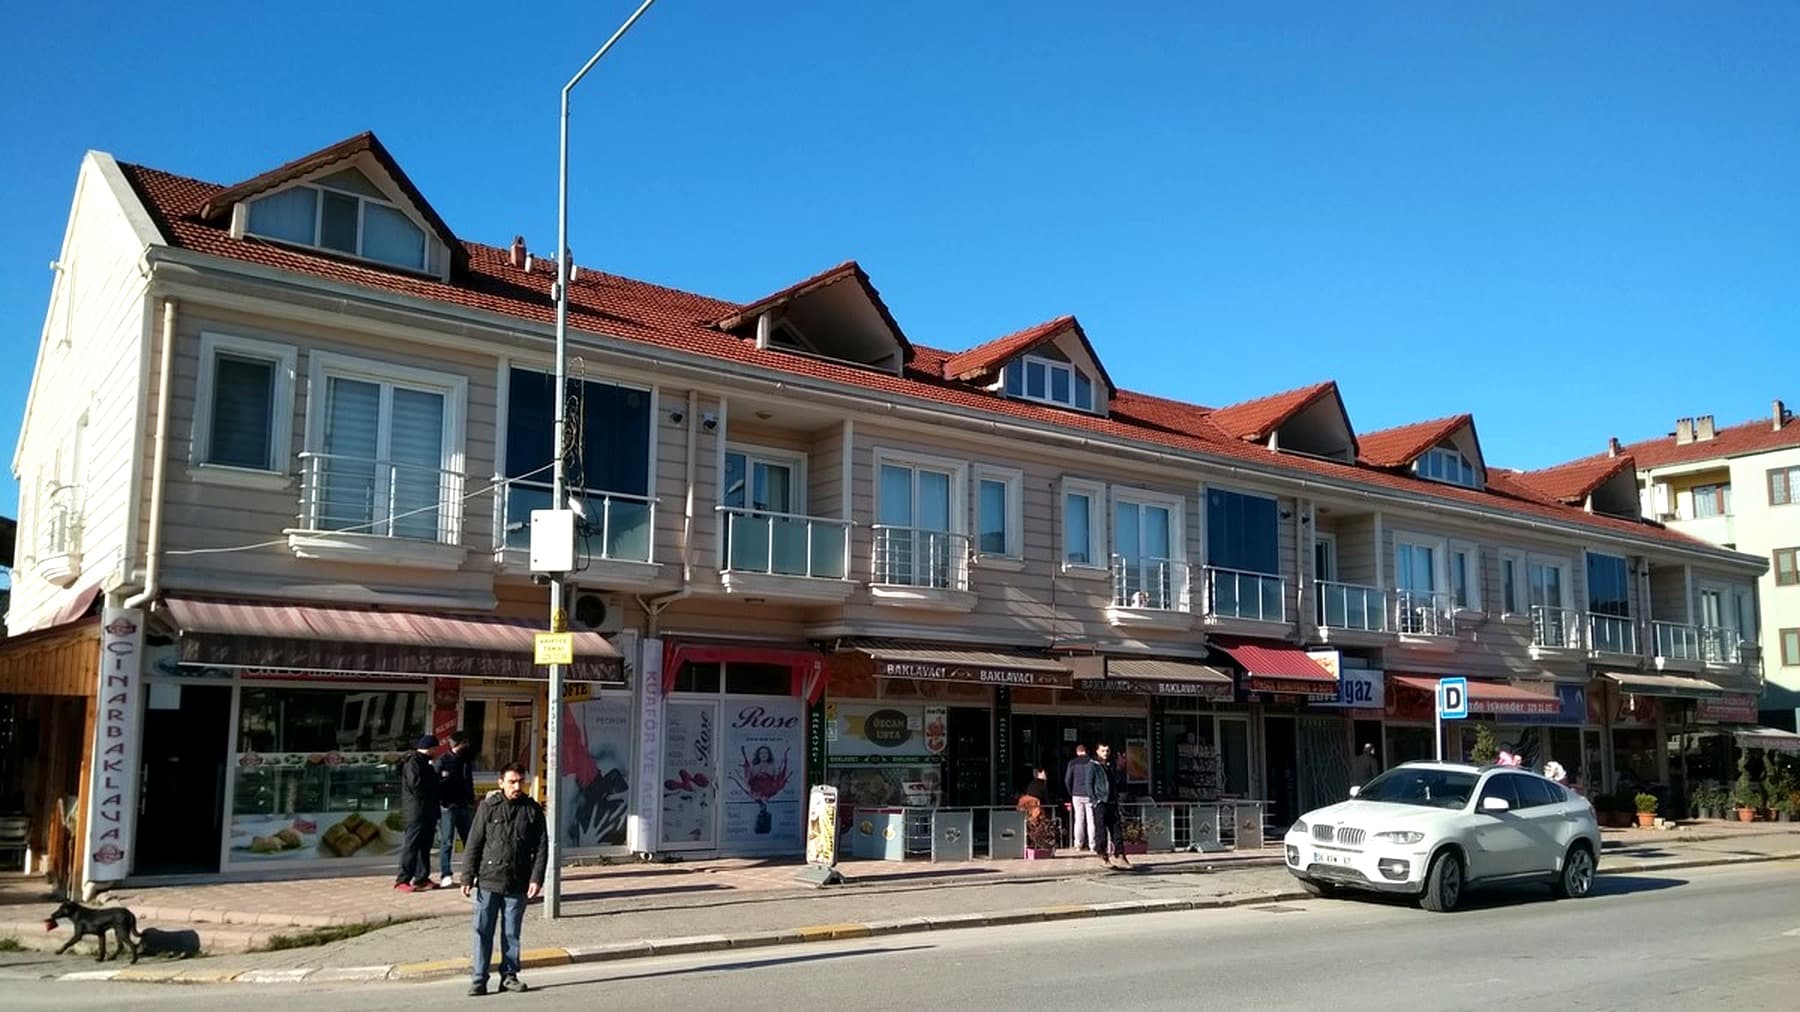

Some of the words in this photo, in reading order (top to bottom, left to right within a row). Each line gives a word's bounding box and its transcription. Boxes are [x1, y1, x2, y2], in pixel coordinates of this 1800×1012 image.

[886, 664, 946, 678] BAKLAVACI
[979, 670, 1034, 684] BAKLAVACI
[1345, 680, 1373, 704] gaz
[1445, 687, 1461, 709] D
[732, 706, 799, 728] Rose
